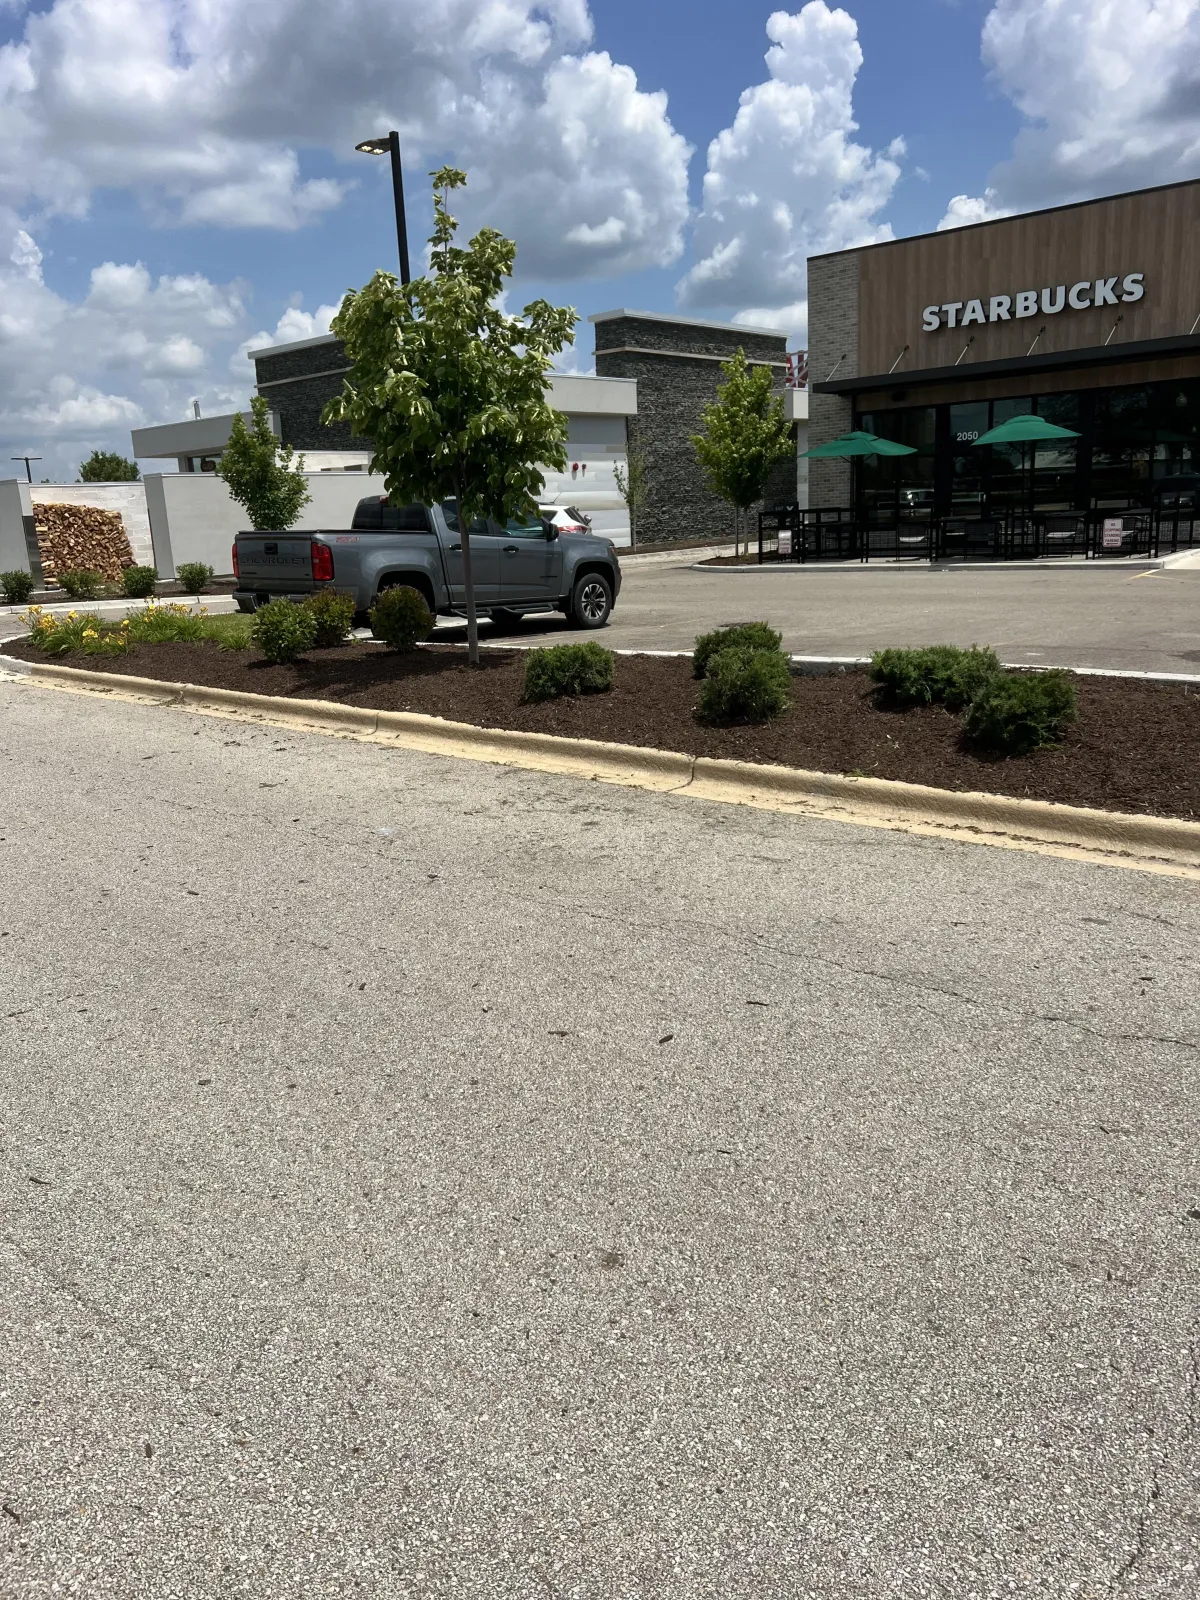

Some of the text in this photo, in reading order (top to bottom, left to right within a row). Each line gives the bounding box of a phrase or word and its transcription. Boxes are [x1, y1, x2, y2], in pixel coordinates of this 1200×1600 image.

[922, 273, 1144, 332] STARBUCKS
[957, 431, 978, 441] 2050
[240, 555, 308, 565] CHEVROLET
